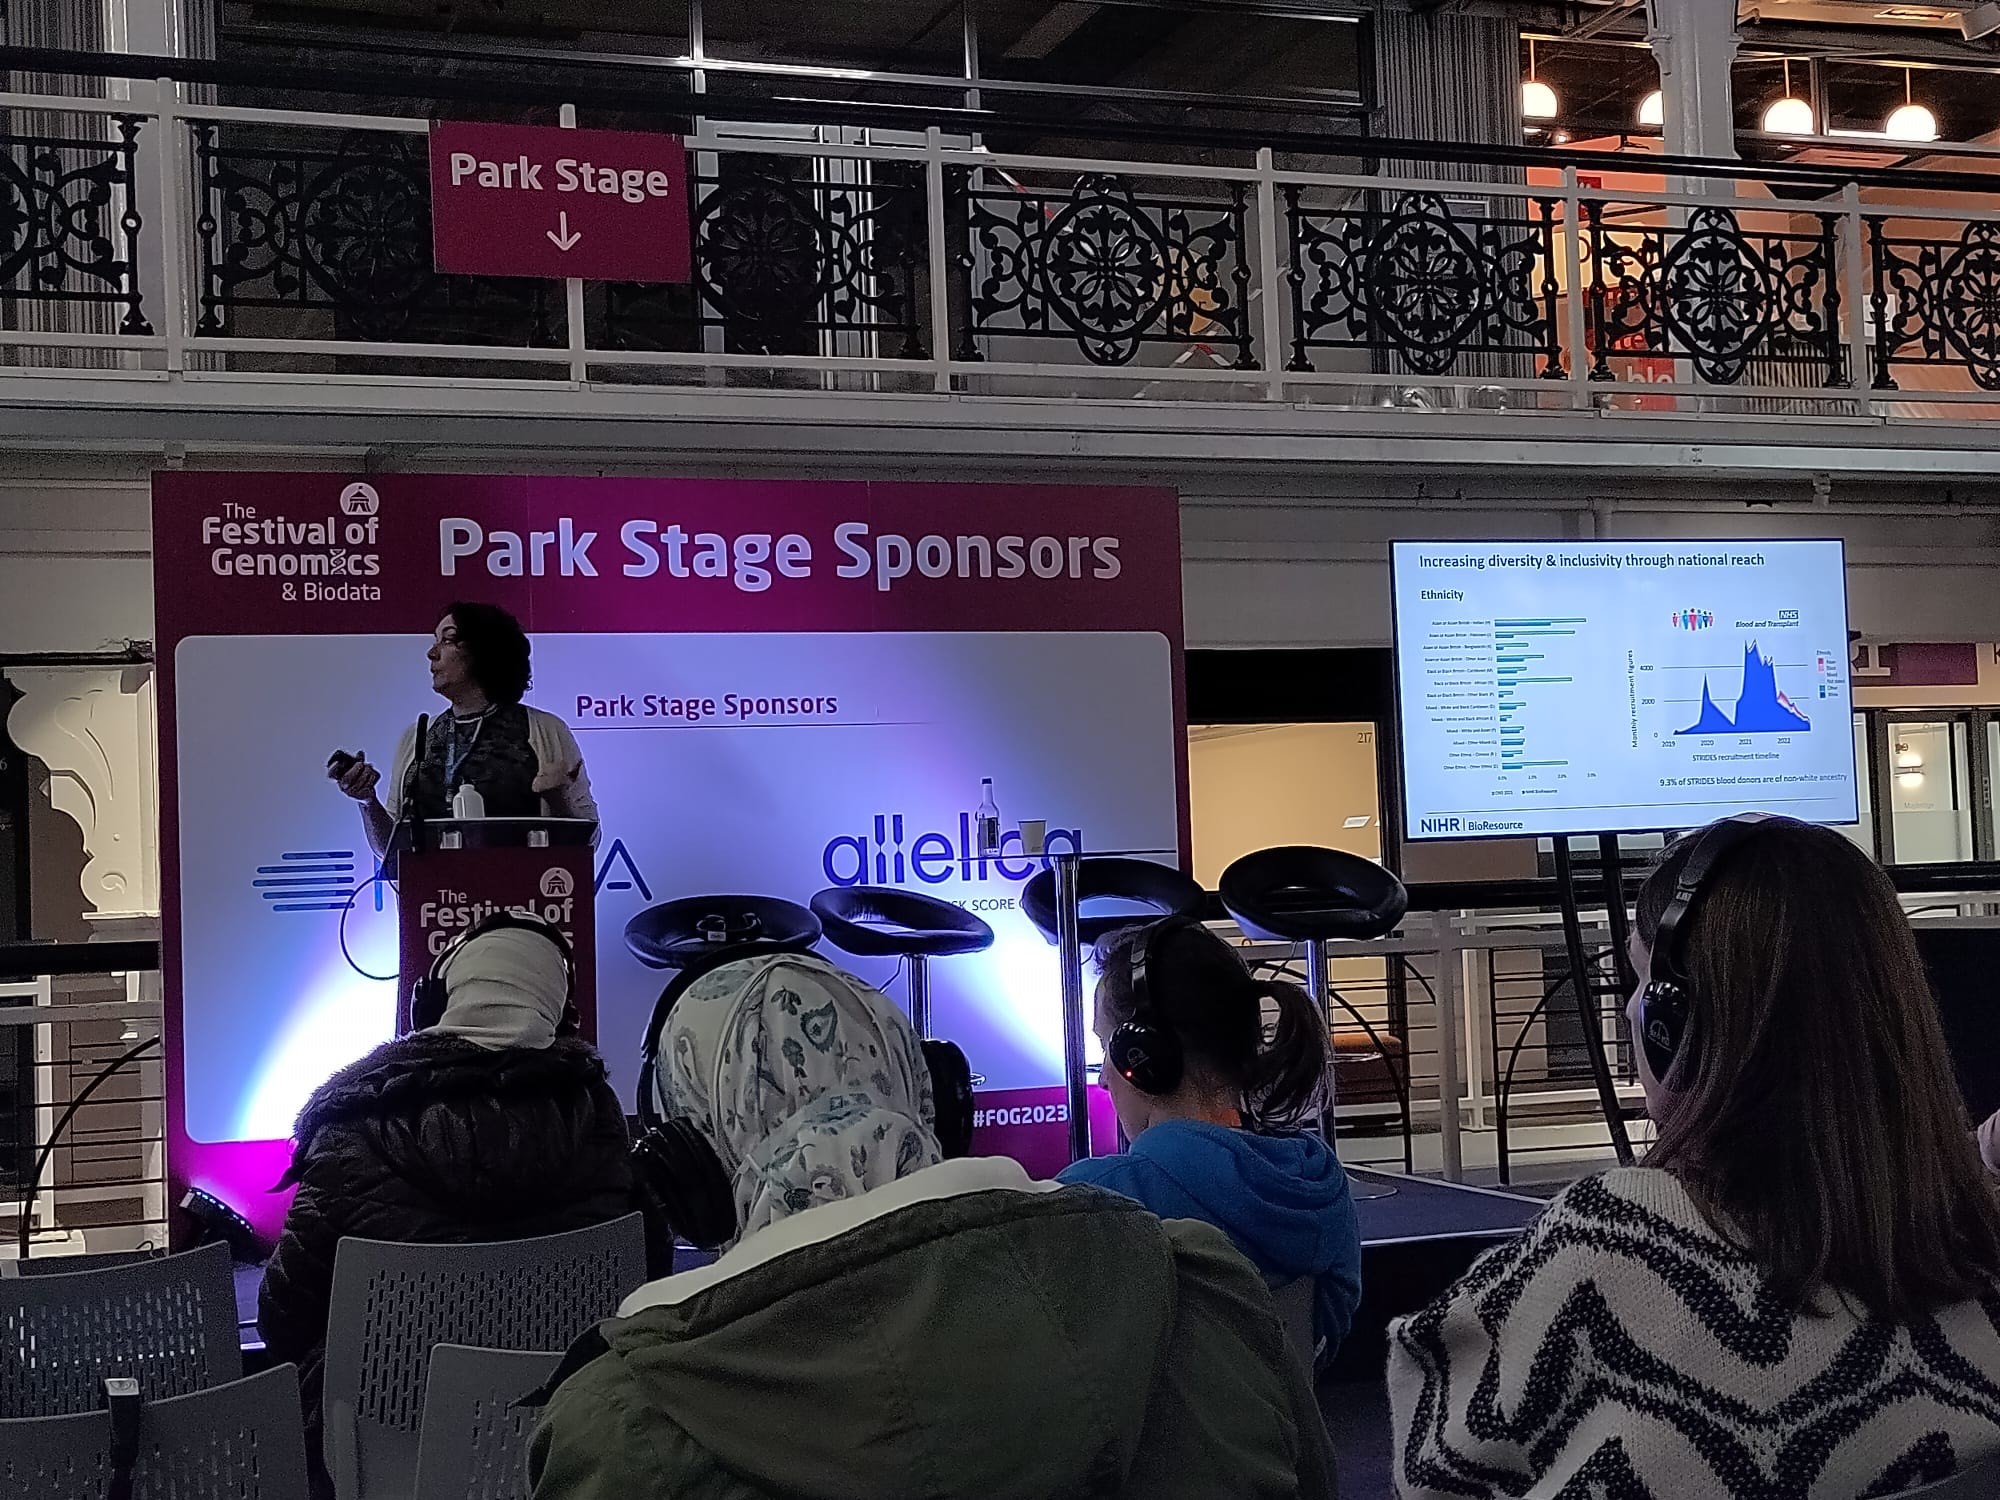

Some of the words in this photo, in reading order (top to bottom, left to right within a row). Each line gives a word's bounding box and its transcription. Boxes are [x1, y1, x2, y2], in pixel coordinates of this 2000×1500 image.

[451, 152, 544, 191] Park
[555, 158, 669, 203] Stage
[222, 502, 256, 520] The
[202, 516, 335, 545] Festival
[345, 516, 379, 544] of
[439, 517, 599, 577] Park
[621, 518, 812, 592] Stage
[834, 521, 1122, 592] Sponsors
[1419, 554, 1485, 570] Increasing
[1488, 554, 1543, 570] diversity
[1546, 554, 1557, 567] &
[1560, 553, 1622, 569] inclusivity
[1626, 553, 1674, 569] through
[1678, 553, 1728, 566] national
[1731, 553, 1765, 566] reach
[281, 582, 298, 601] &
[304, 581, 381, 601] Biodata
[1421, 590, 1464, 602] Ethnicity
[1779, 610, 1798, 619] NHS
[576, 694, 636, 718] Park
[642, 693, 716, 722] Stage
[723, 692, 838, 721] Sponsors
[1357, 731, 1373, 744] 217
[1755, 751, 1780, 759] timeline
[1659, 779, 1677, 787] 9.3%
[1717, 776, 1736, 784] blood
[1737, 776, 1762, 784] donors
[1775, 774, 1783, 783] of
[1819, 773, 1848, 782] ancestry
[1420, 817, 1461, 833] NIHR
[1468, 820, 1524, 832] BioResource
[437, 889, 468, 904] The
[971, 898, 1016, 911] SCORE
[544, 897, 574, 924] of
[973, 1103, 1069, 1127] #FOG2023
